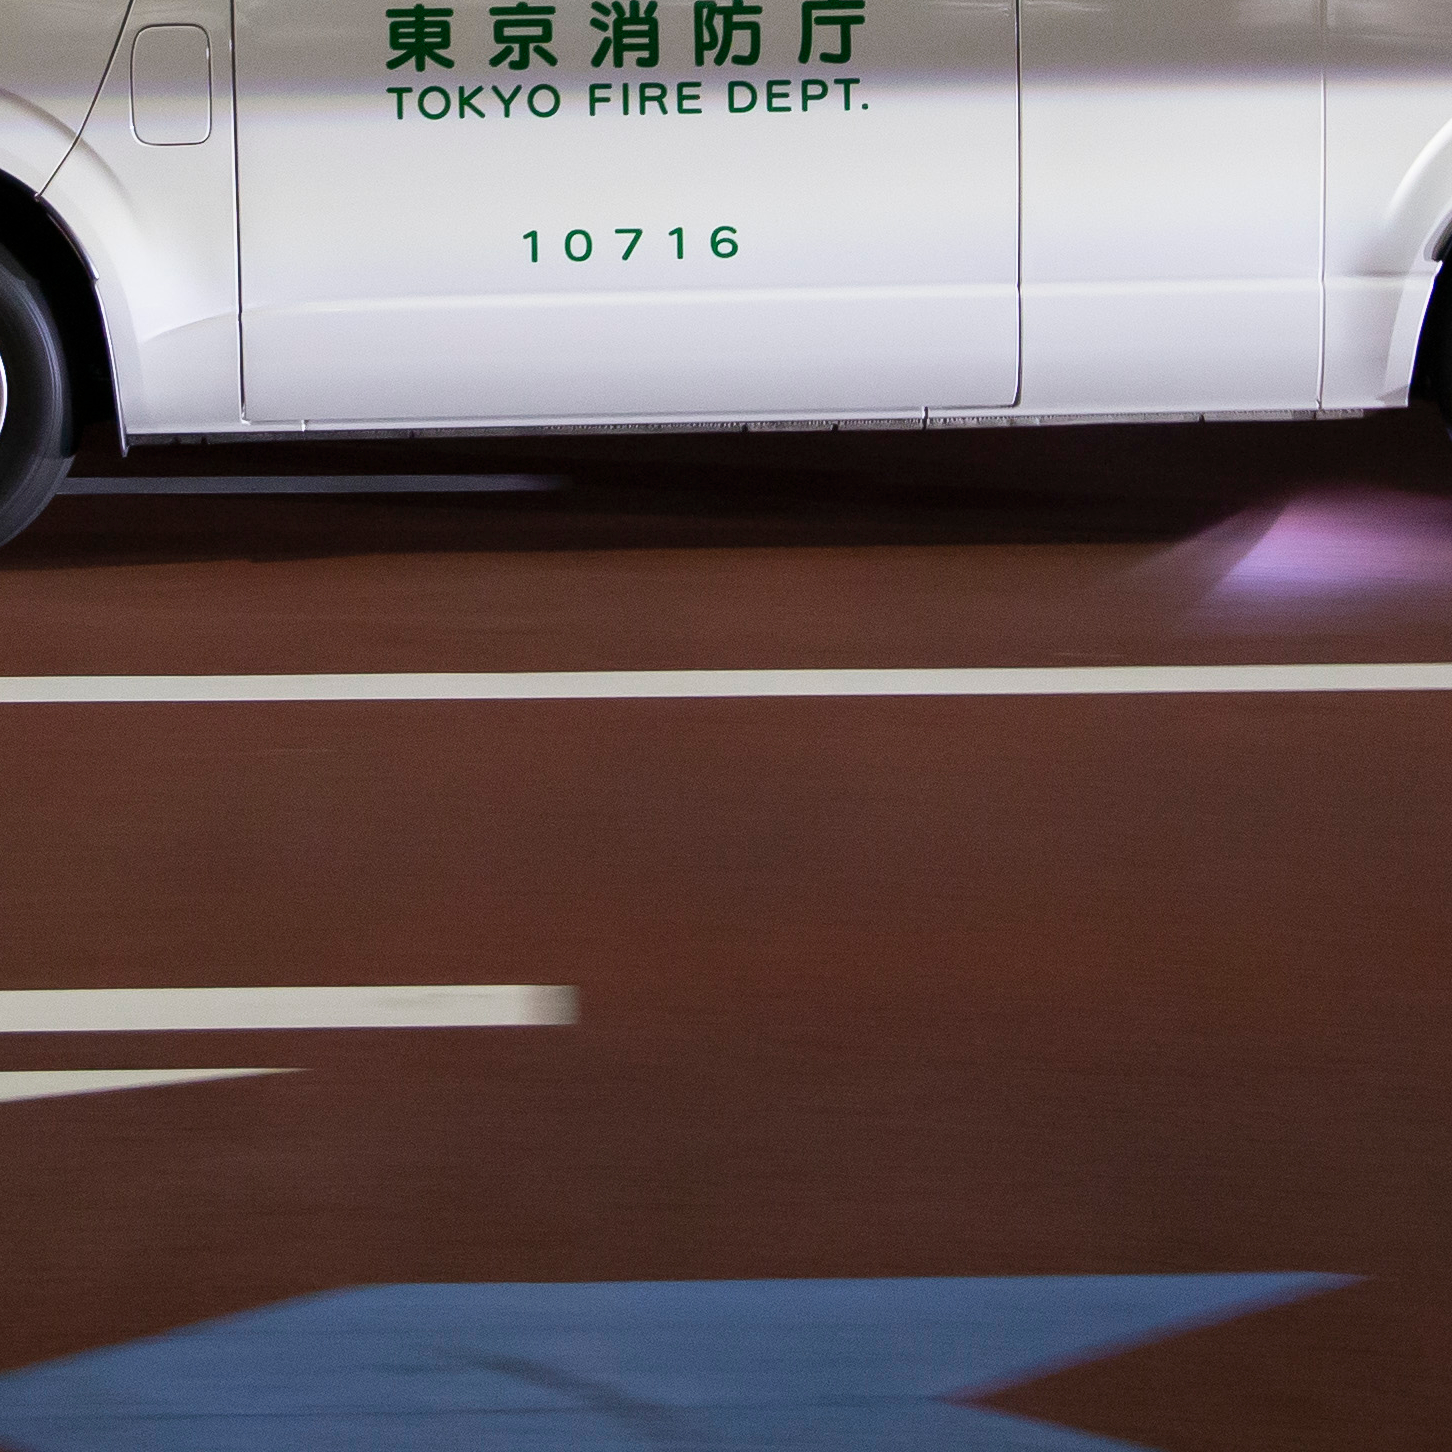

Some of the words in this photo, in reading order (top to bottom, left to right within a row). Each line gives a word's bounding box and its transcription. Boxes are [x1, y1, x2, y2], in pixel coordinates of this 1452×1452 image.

[385, 84, 561, 121] TOKYO
[588, 81, 704, 117] FIRE
[727, 77, 870, 114] DEPT.
[522, 225, 740, 264] 10716
